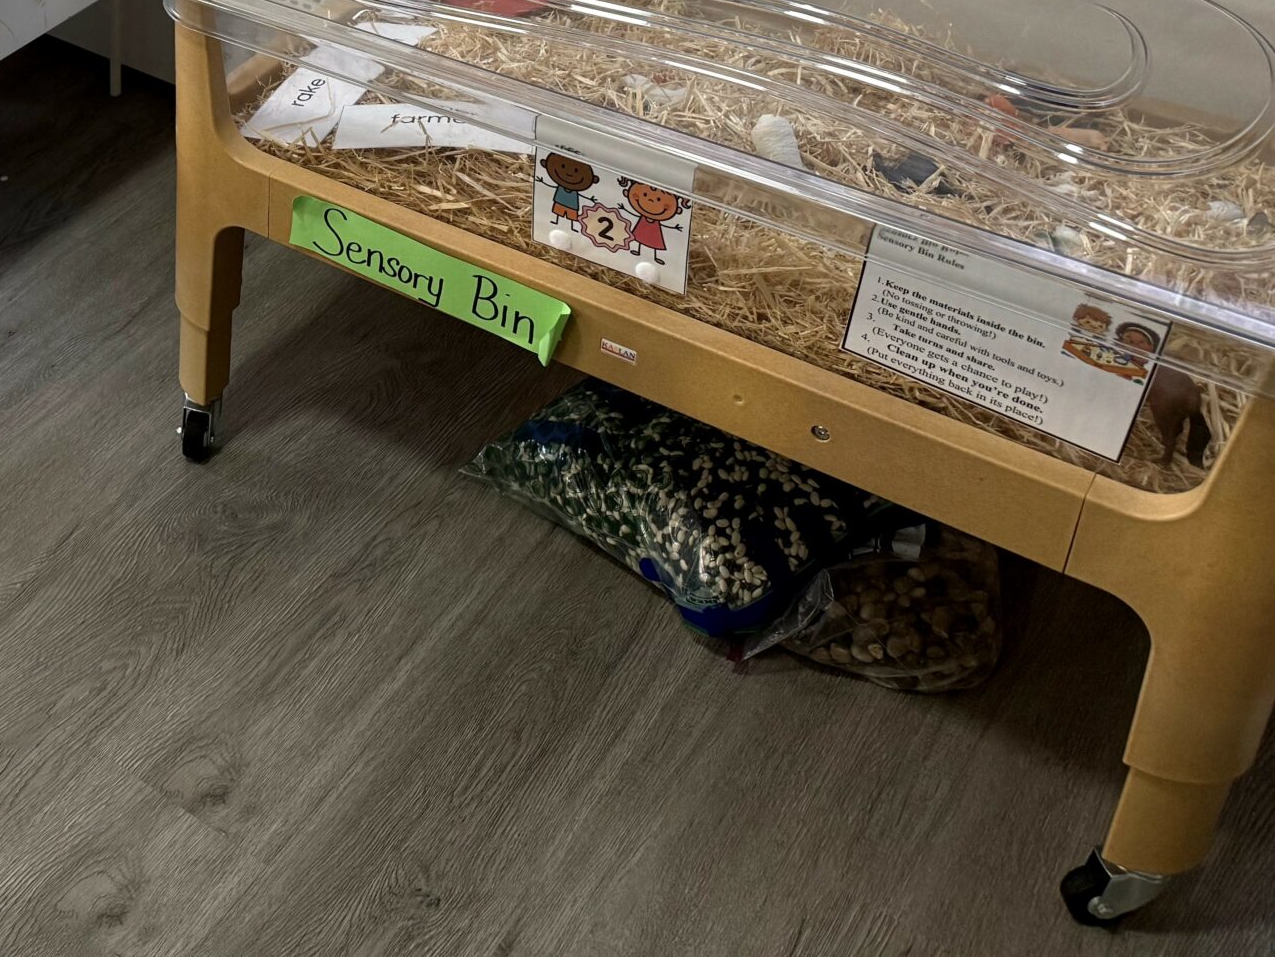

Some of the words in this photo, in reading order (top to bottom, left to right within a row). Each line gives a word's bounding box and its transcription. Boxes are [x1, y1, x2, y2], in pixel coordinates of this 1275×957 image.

[291, 77, 326, 108] rake
[598, 216, 615, 241] 2
[878, 233, 916, 252] Sensory
[918, 246, 934, 259] Bin
[937, 254, 965, 270] Rules
[312, 208, 444, 308] Sensory
[472, 274, 535, 345] Bin
[866, 312, 875, 322] 3.
[893, 323, 917, 338] Take
[918, 335, 943, 350] turns
[945, 347, 965, 358] and
[966, 355, 995, 371] share.
[871, 294, 879, 303] 2.
[881, 297, 898, 309] Use
[899, 307, 928, 322] gentle
[930, 318, 961, 336] hands.
[877, 276, 884, 285] 1.
[885, 280, 910, 295] Keep
[912, 291, 927, 301] the
[929, 298, 975, 320] materials
[976, 315, 1006, 333] inside
[1008, 328, 1025, 340] the
[1027, 335, 1045, 349] bin.
[882, 289, 900, 301] (No
[901, 297, 933, 316] tossing
[935, 311, 946, 319] or
[947, 315, 997, 340] throwing!)
[601, 340, 636, 361] KALAN
[861, 333, 870, 342] 4.
[887, 343, 918, 362] Clean
[921, 360, 936, 370] up
[939, 365, 968, 383] when
[971, 380, 1010, 399] you're
[1011, 396, 1043, 414] done.
[872, 326, 925, 353] (Everyone
[927, 350, 950, 364] gets
[961, 363, 999, 383] chance
[1001, 379, 1012, 389] to
[1014, 386, 1048, 404] play!)
[877, 307, 893, 317] (Be
[895, 313, 915, 327] kind
[917, 323, 934, 334] and
[935, 330, 967, 348] careful
[970, 344, 990, 357] with
[992, 353, 1015, 367] tools
[1017, 364, 1035, 375] and
[1037, 371, 1065, 388] toys.)
[867, 346, 888, 361] (Put
[890, 357, 945, 385] everything
[948, 380, 973, 396] back
[976, 391, 987, 402] in
[989, 397, 1003, 408] its
[1005, 405, 1044, 425] place!)
